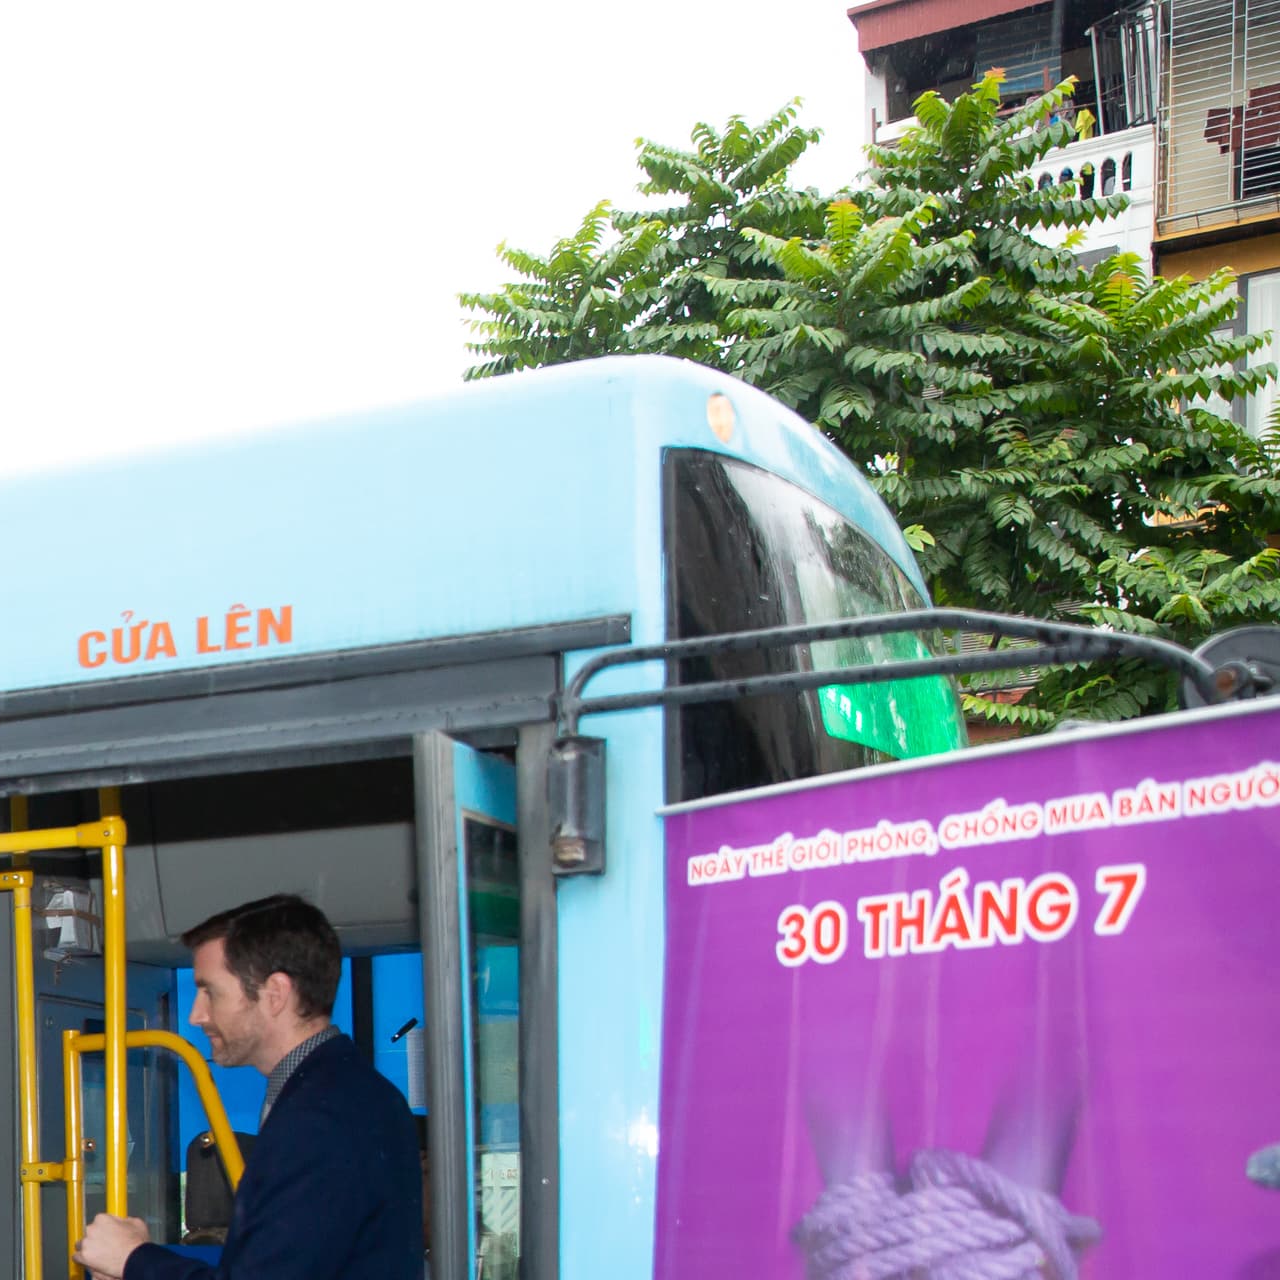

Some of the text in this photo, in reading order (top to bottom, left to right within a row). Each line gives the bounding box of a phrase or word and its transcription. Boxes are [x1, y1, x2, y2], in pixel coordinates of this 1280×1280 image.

[77, 603, 293, 669] CỬA LÊN
[689, 764, 1280, 883] NGÀY THẾ GIỚI PHÒNG, CHỐNG MUA BÁN NGƯỜ
[780, 867, 1143, 963] 30 THÁNG 7
